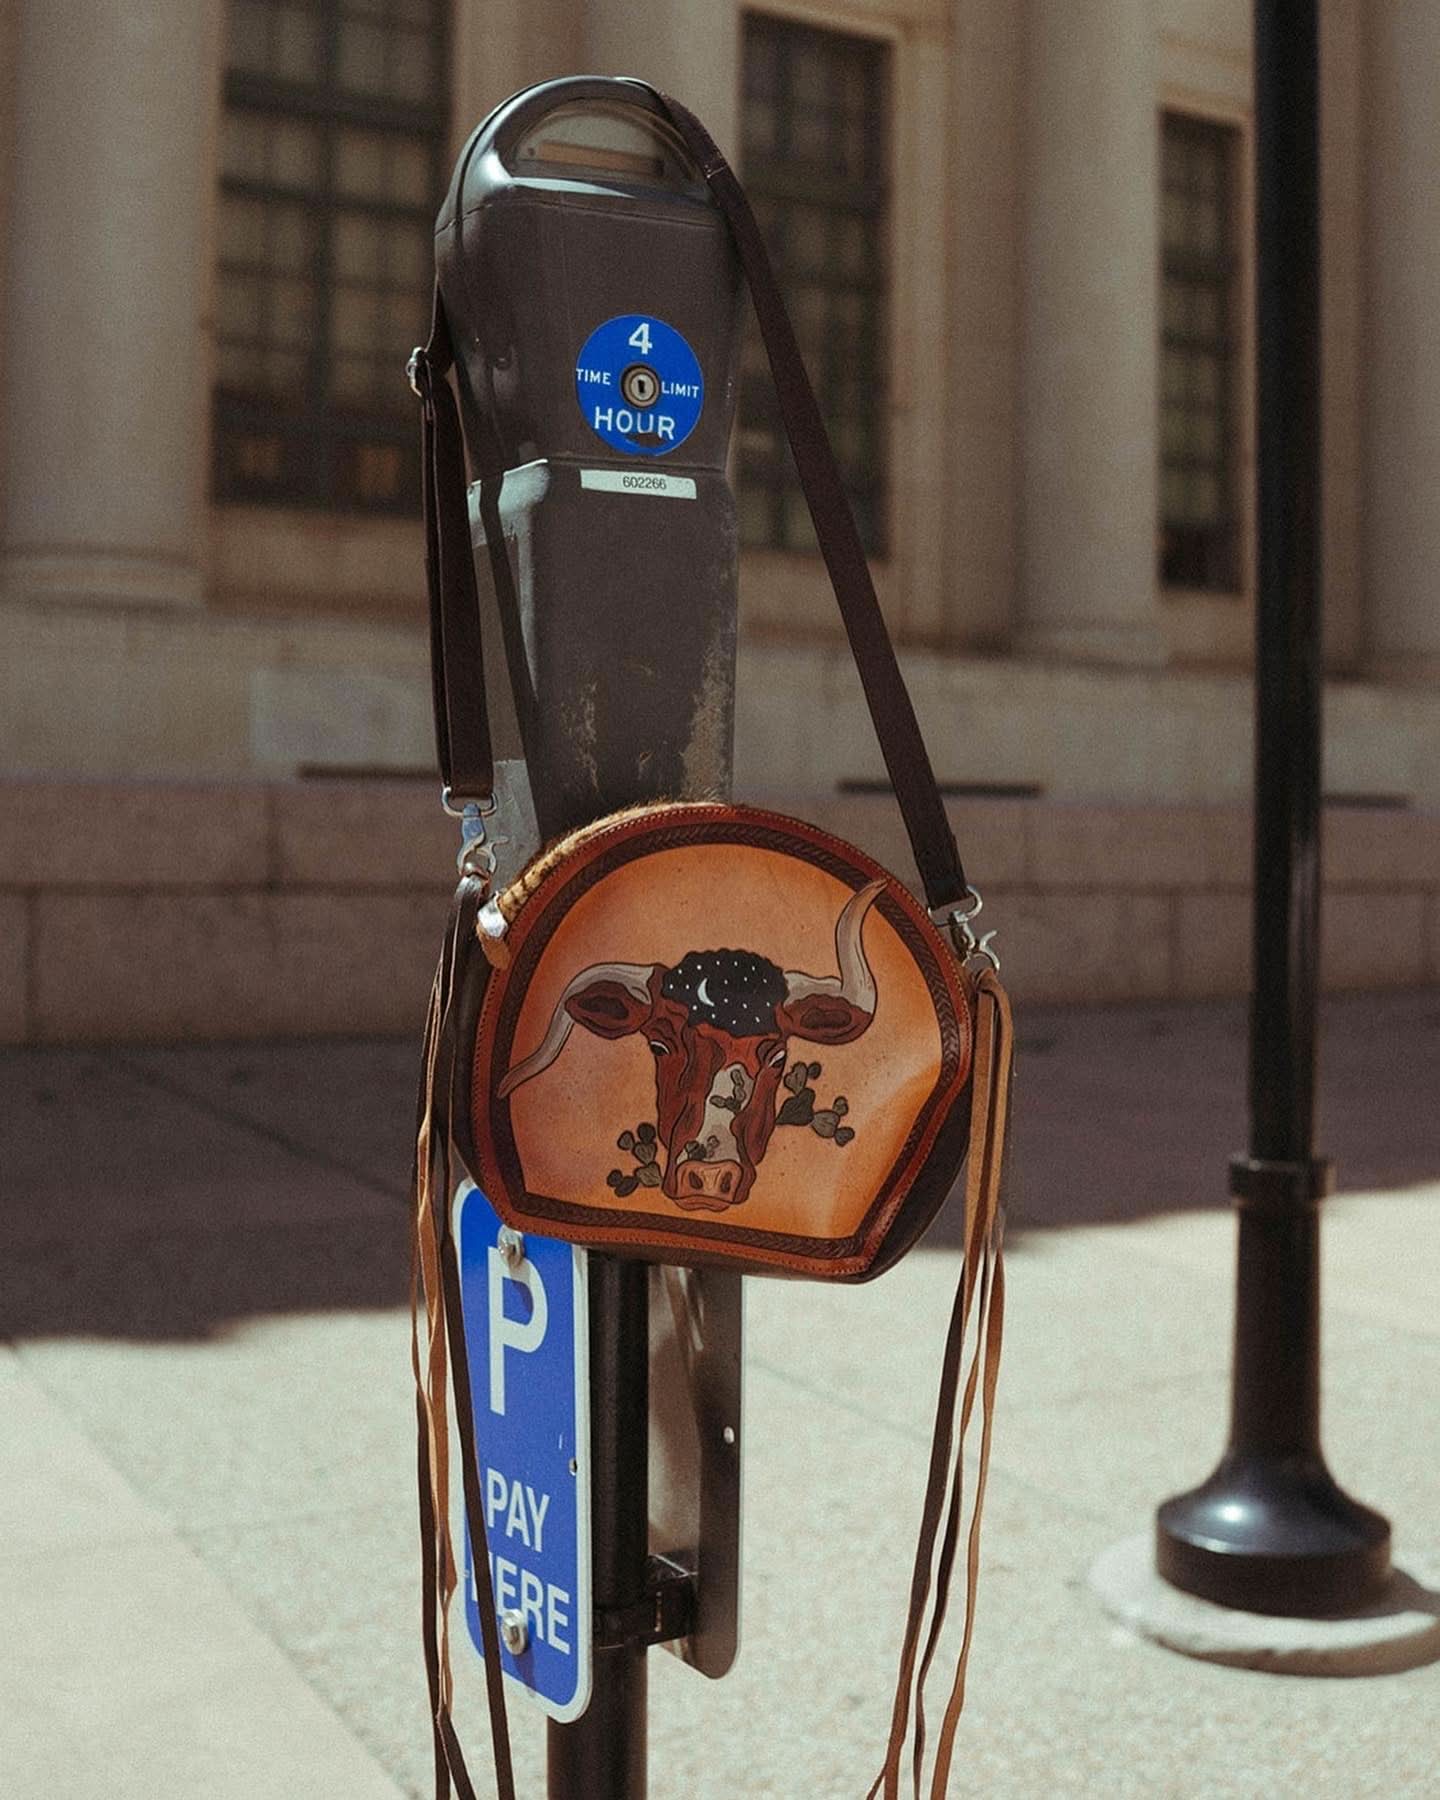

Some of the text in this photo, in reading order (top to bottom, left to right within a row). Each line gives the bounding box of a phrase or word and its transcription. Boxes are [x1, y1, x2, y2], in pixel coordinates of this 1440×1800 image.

[628, 322, 653, 355] 4
[576, 368, 700, 399] TIME LIMIT
[594, 406, 676, 441] HOUR
[622, 475, 668, 490] 602266
[487, 1245, 549, 1416] P
[486, 1466, 550, 1553] PAY
